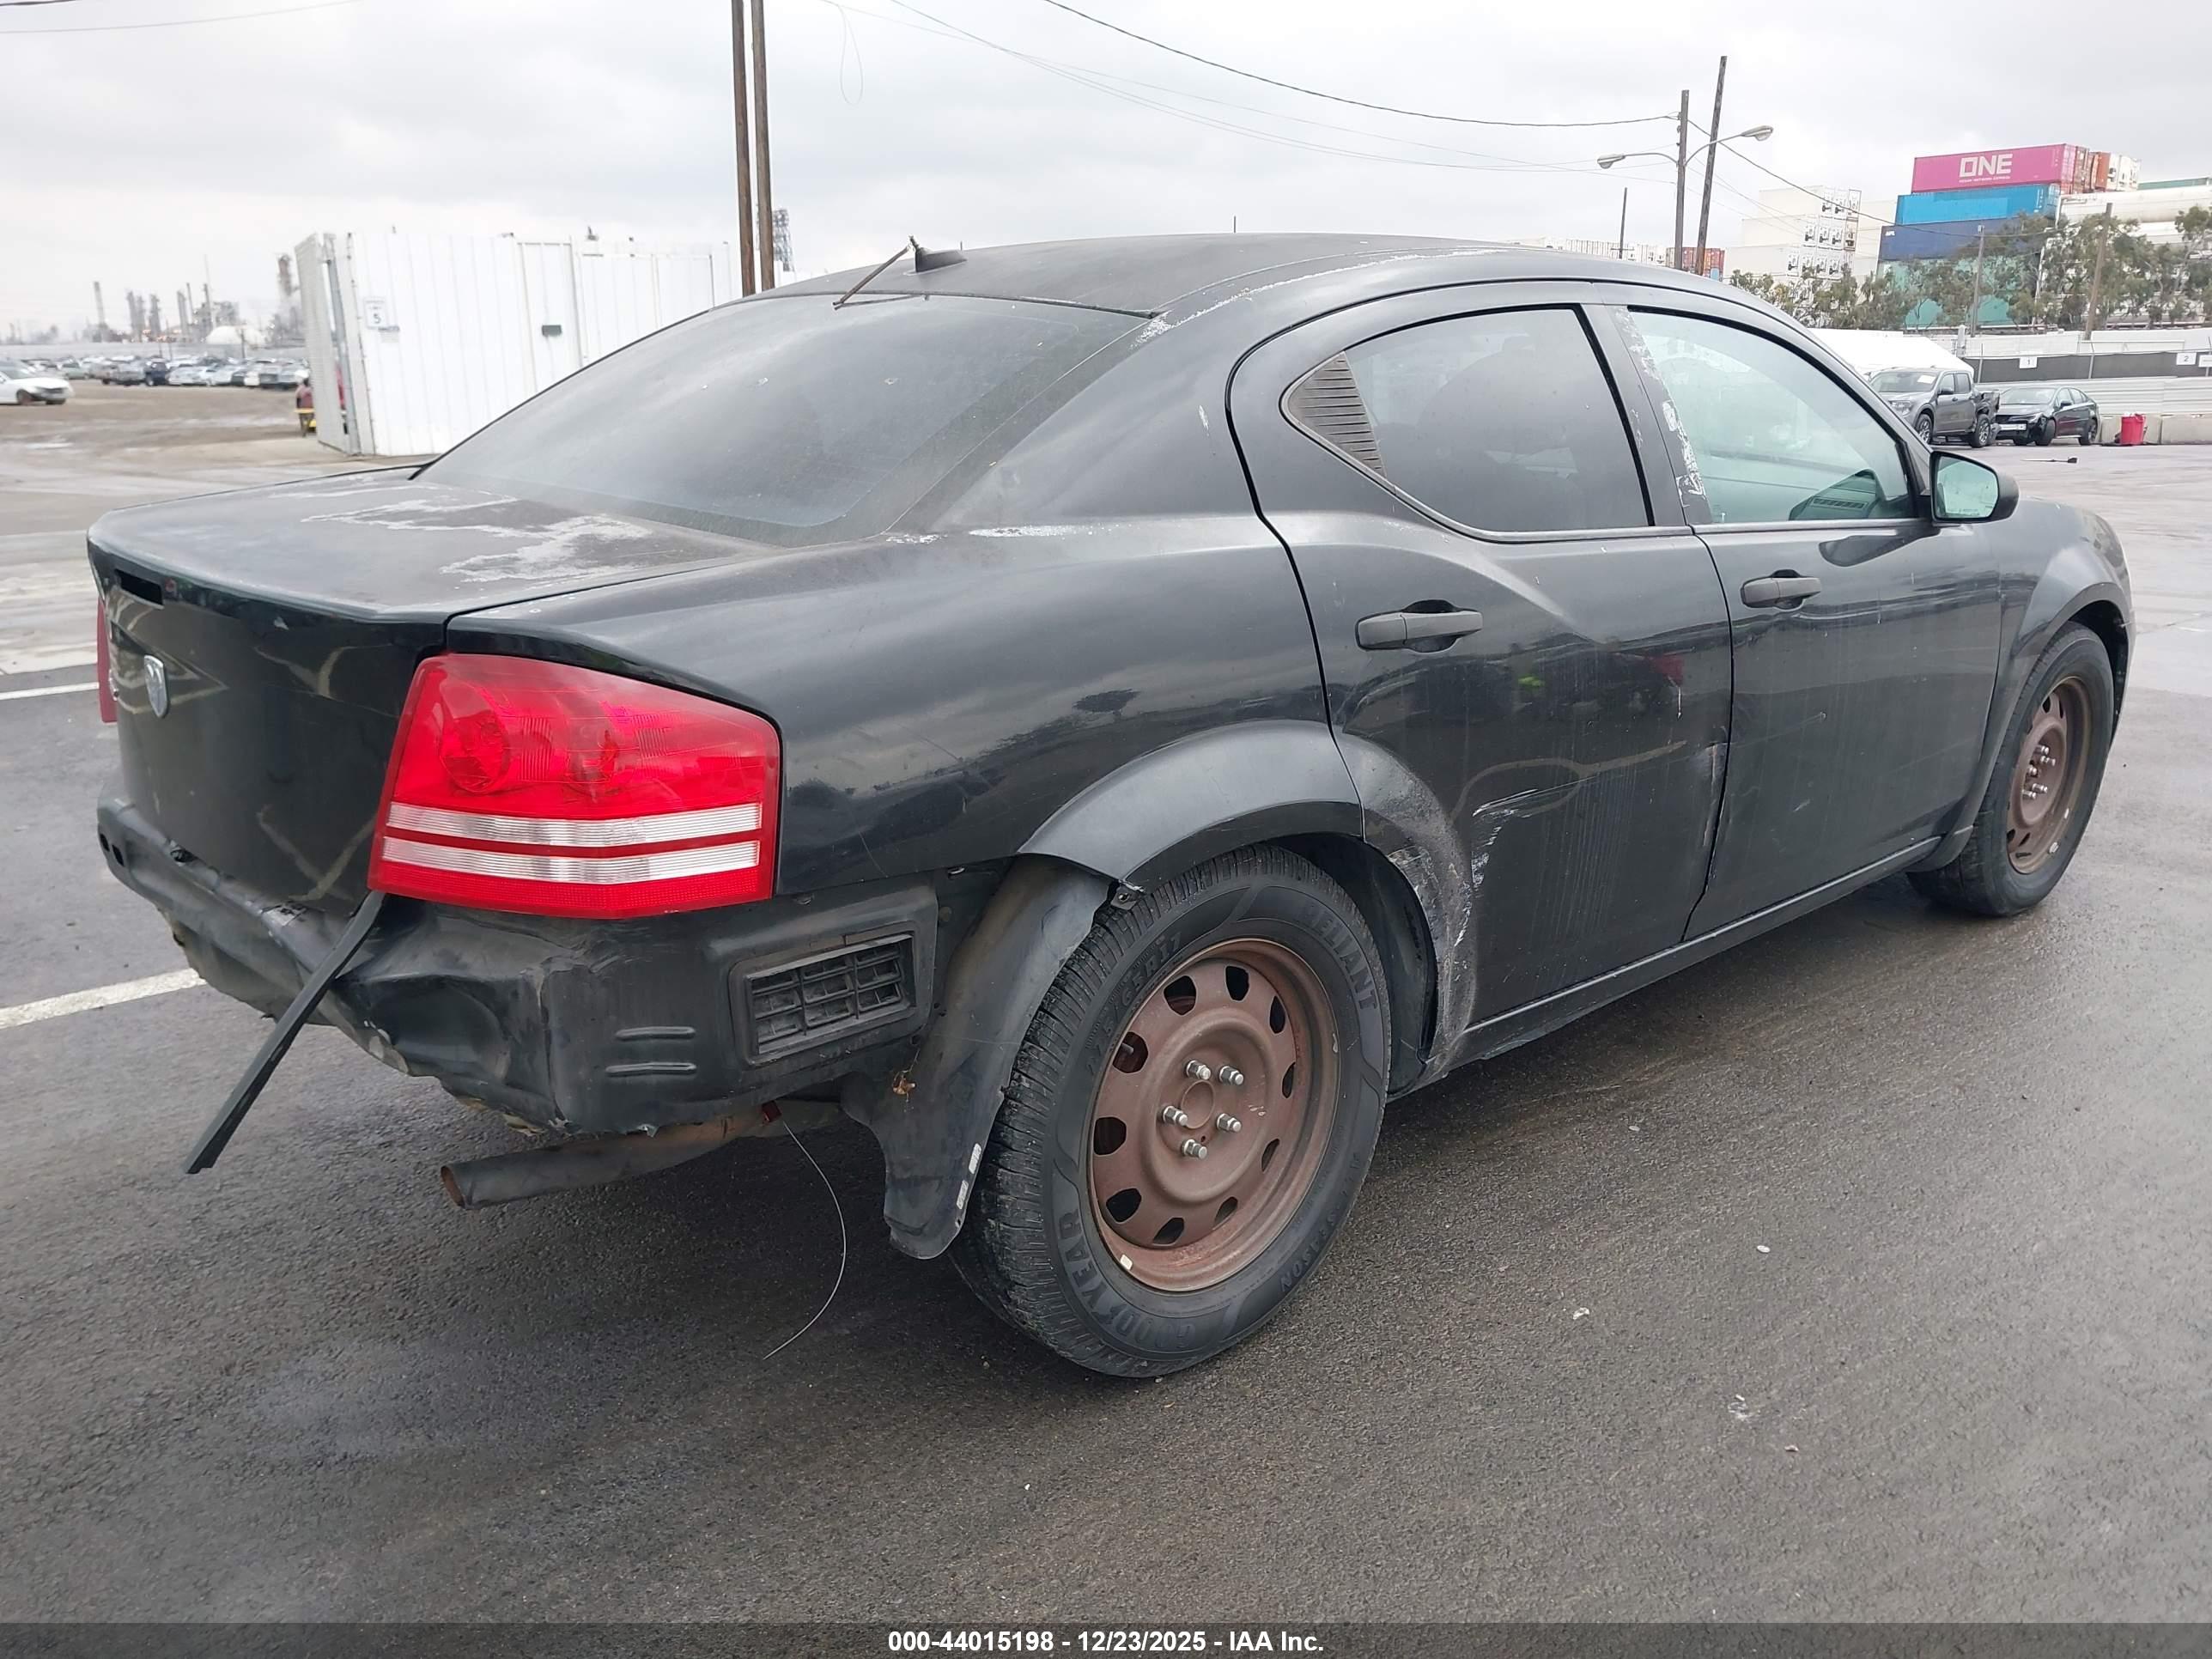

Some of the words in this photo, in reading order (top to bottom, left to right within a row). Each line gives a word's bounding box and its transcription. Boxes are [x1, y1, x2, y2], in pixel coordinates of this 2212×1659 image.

[1959, 153, 2014, 178] ONE
[1293, 902, 1378, 1010] RELIANT
[1057, 1207, 1195, 1348] GOODYEAR
